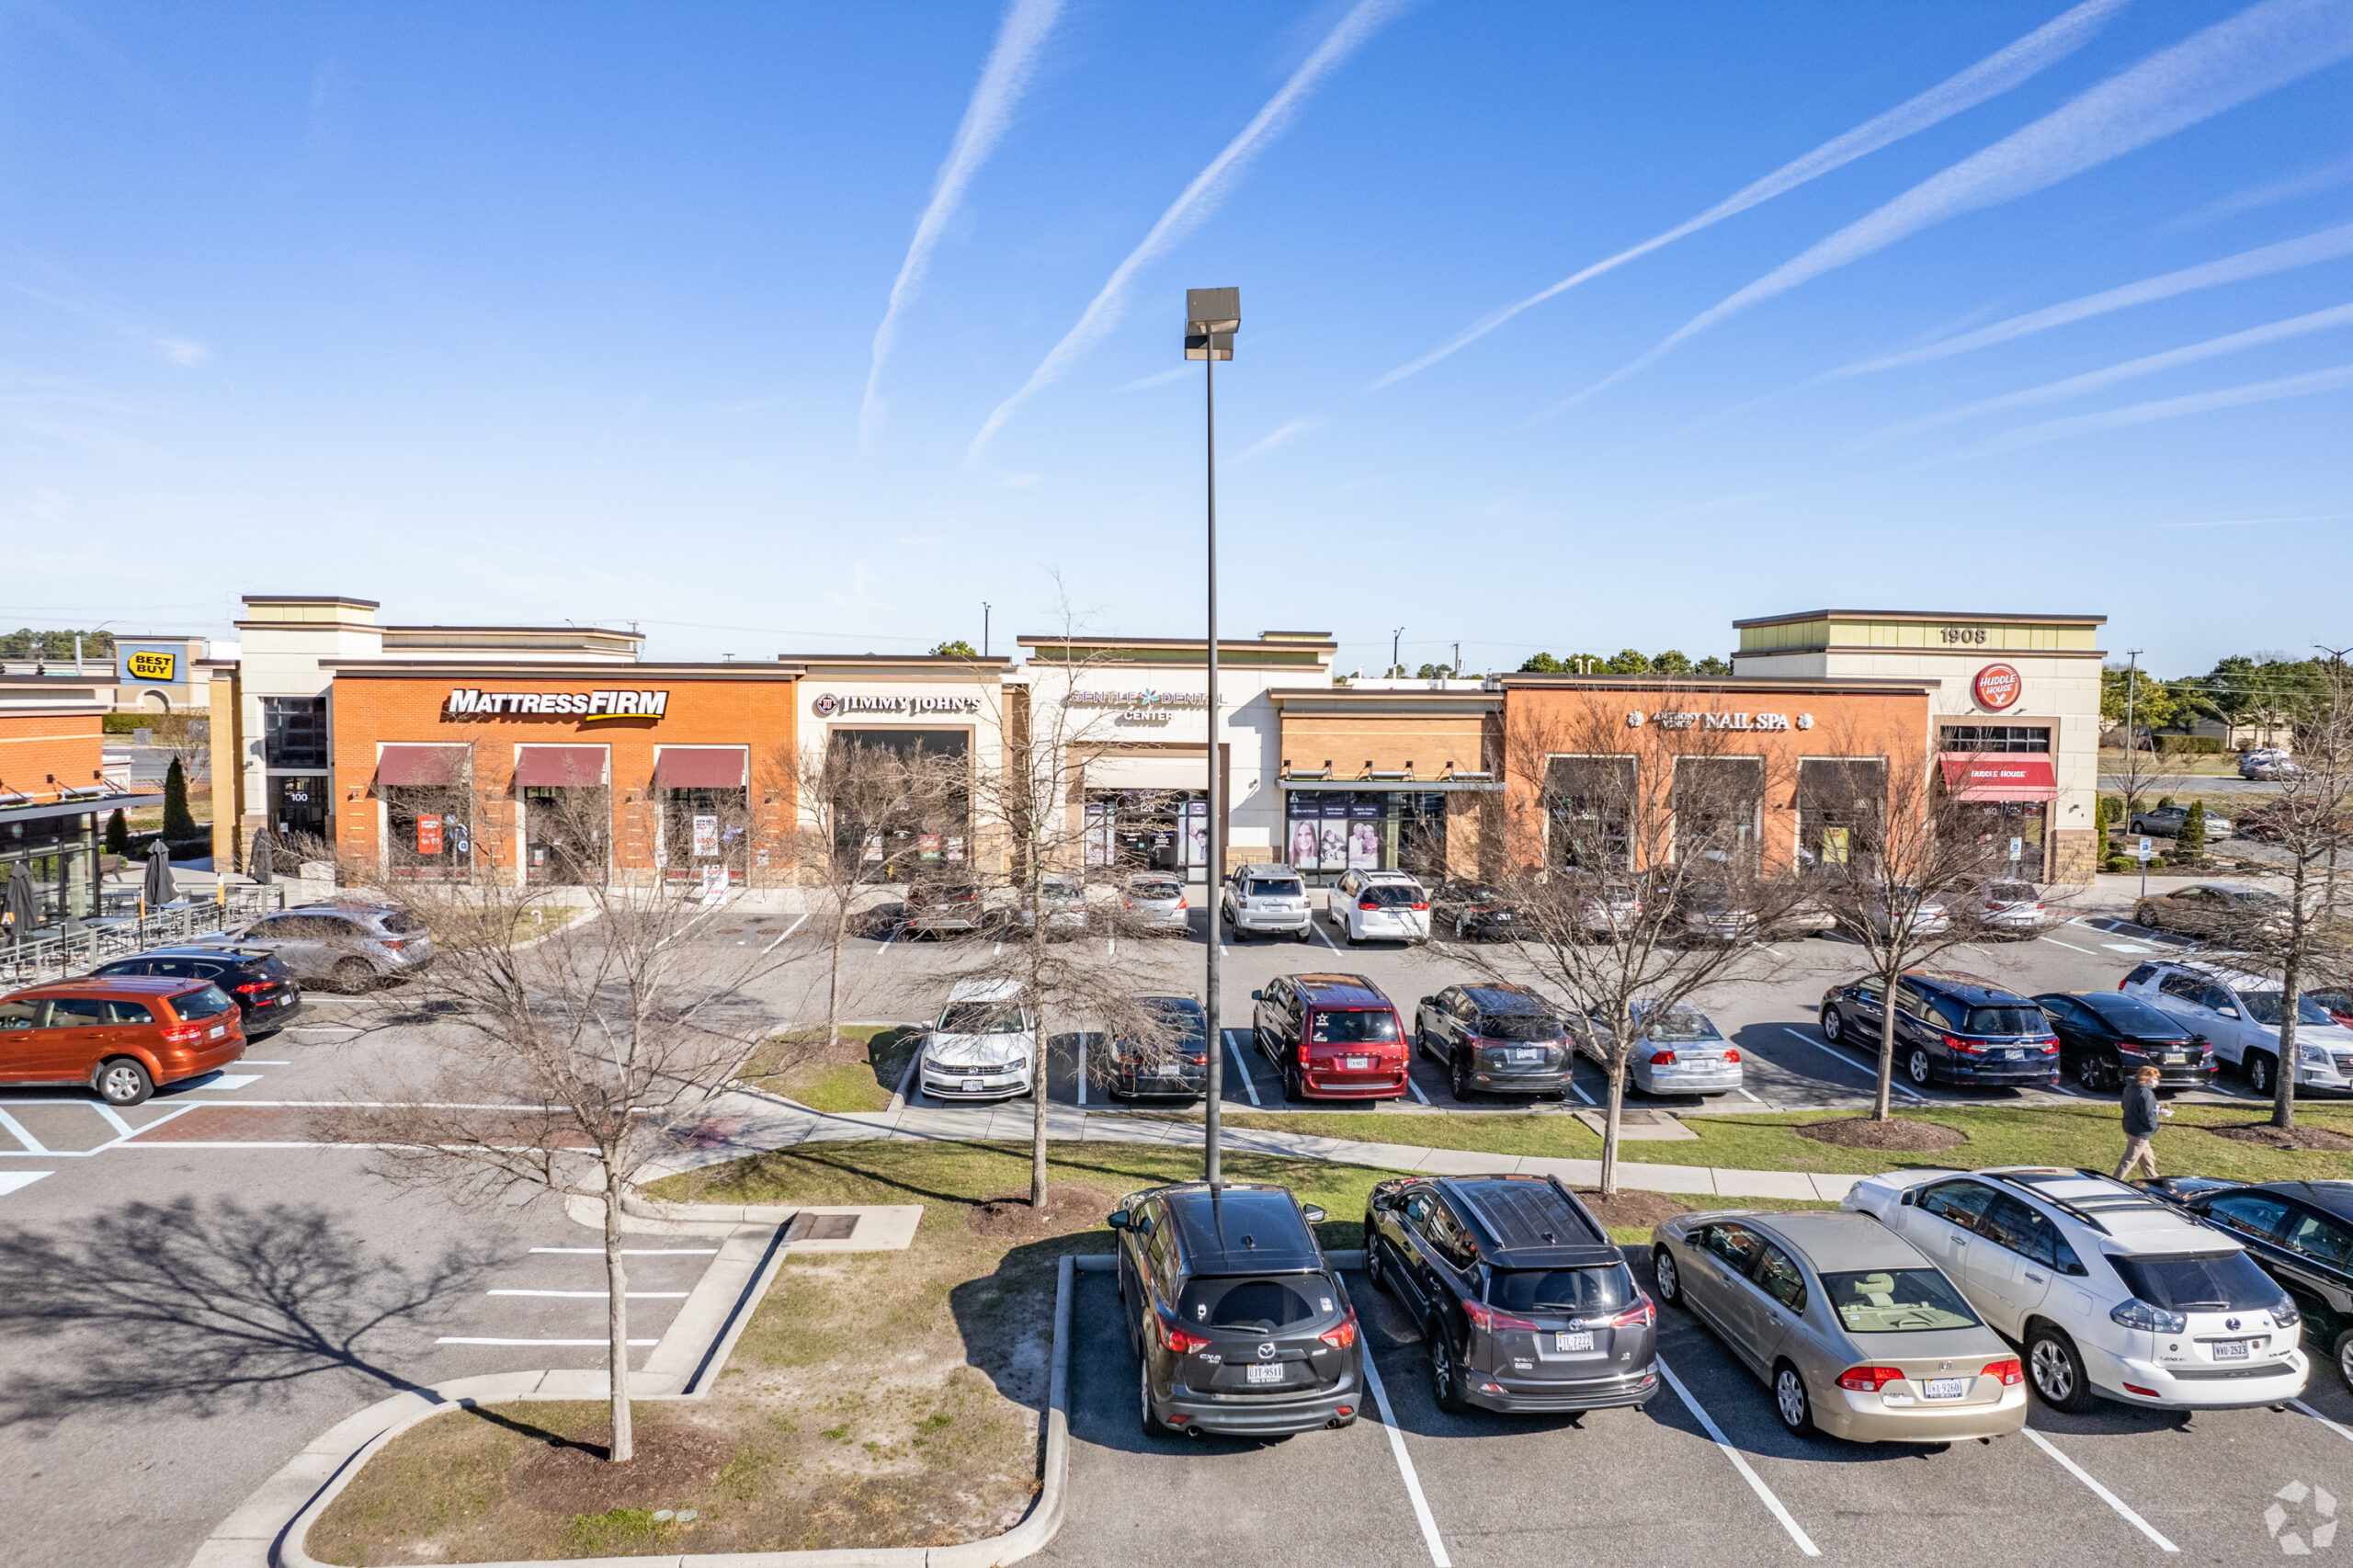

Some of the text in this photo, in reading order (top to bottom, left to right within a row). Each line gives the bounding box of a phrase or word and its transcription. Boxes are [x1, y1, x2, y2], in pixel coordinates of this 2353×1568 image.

[1940, 628, 1987, 643] 1908
[135, 655, 171, 665] BEST
[136, 665, 167, 674] BUY
[1980, 674, 2017, 687] HUDDLE
[1986, 684, 2013, 695] HOUSE
[1070, 691, 1229, 705] GENTLE DENTL
[842, 696, 982, 713] JIMMY JOHN'S
[1123, 711, 1174, 722] CENTER
[1705, 712, 1791, 730] NAIL SPA
[290, 793, 308, 801] 100
[1140, 804, 1155, 812] 120
